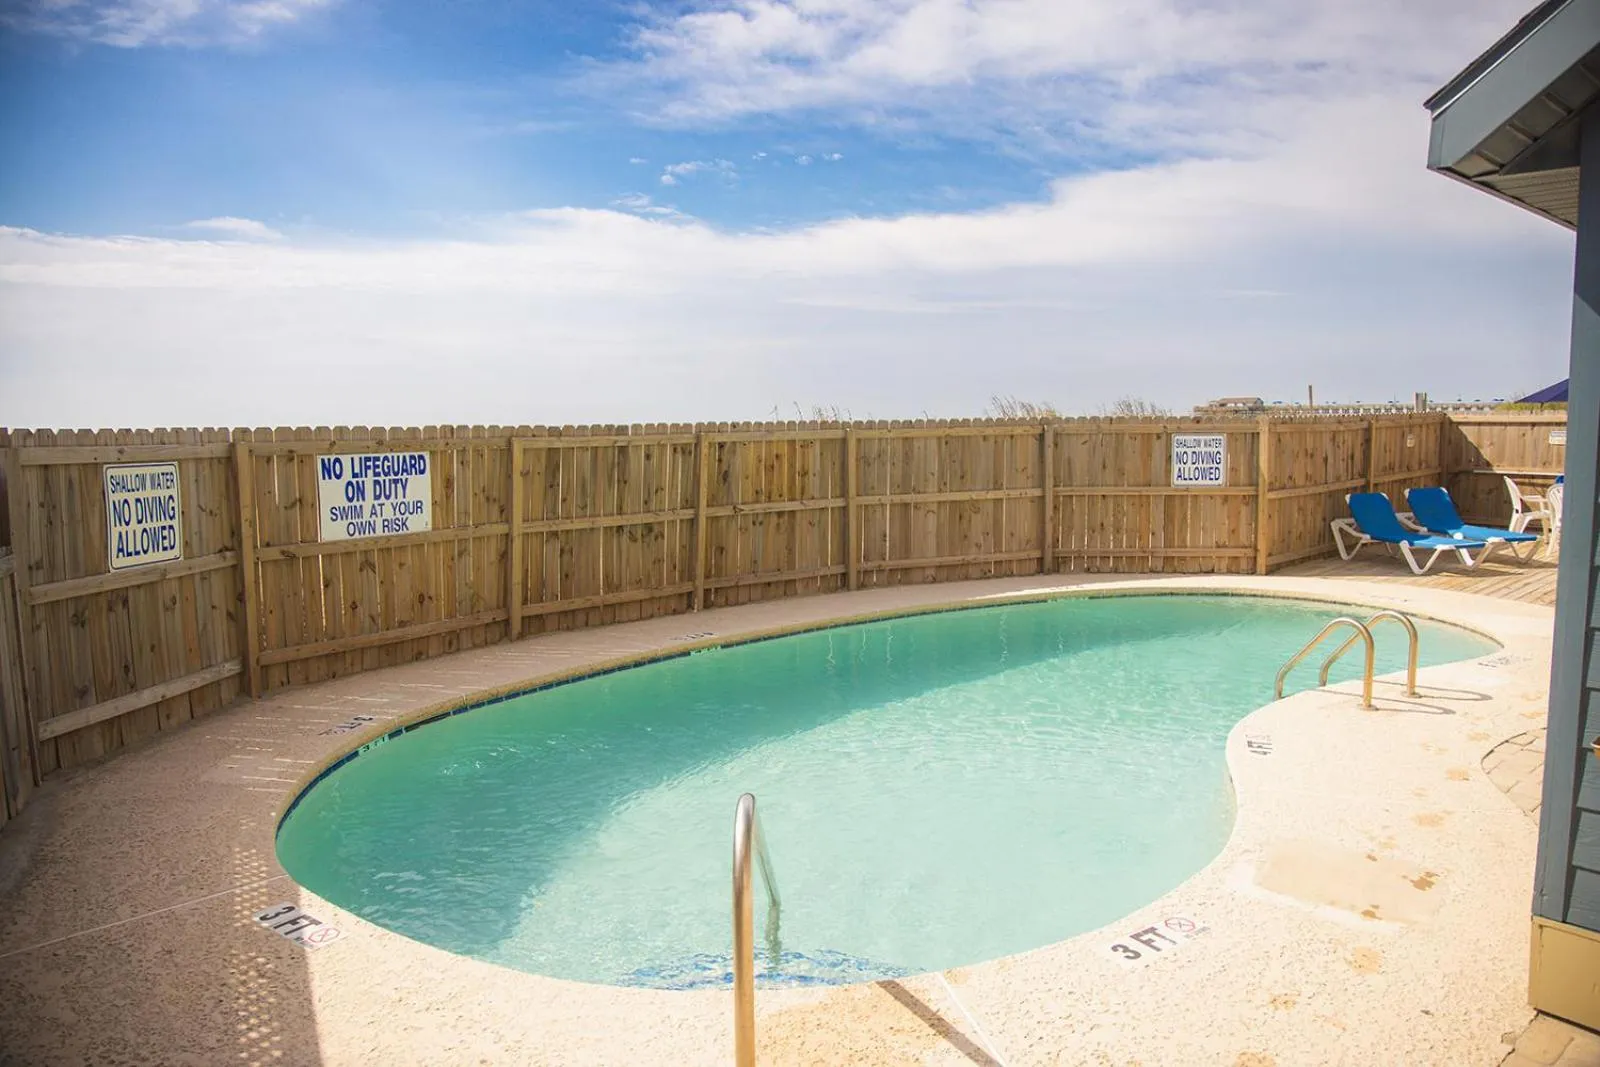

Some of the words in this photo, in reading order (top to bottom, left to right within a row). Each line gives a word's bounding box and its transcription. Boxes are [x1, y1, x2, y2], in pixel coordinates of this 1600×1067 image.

[1175, 438, 1202, 449] SHALLOW
[1203, 438, 1222, 449] WATER
[320, 457, 344, 480] NO
[351, 454, 426, 479] LIFEGUARD
[1175, 450, 1189, 465] NO
[1191, 450, 1222, 465] DIVING
[110, 474, 147, 494] SHALLOW
[149, 472, 175, 490] WATER
[1176, 466, 1221, 481] ALLOWED
[345, 480, 366, 503] ON
[373, 478, 409, 501] DUTY
[113, 498, 131, 527] NO
[135, 494, 176, 525] DIVING
[329, 505, 364, 522] SWIM
[370, 503, 386, 518] AT
[391, 500, 424, 516] YOUR
[346, 520, 376, 537] OWN
[382, 517, 409, 533] RISK
[116, 524, 176, 559] ALLOWED
[259, 905, 296, 921] 3
[273, 914, 323, 935] FT
[1111, 944, 1142, 960] 3
[1129, 926, 1178, 952] FT
